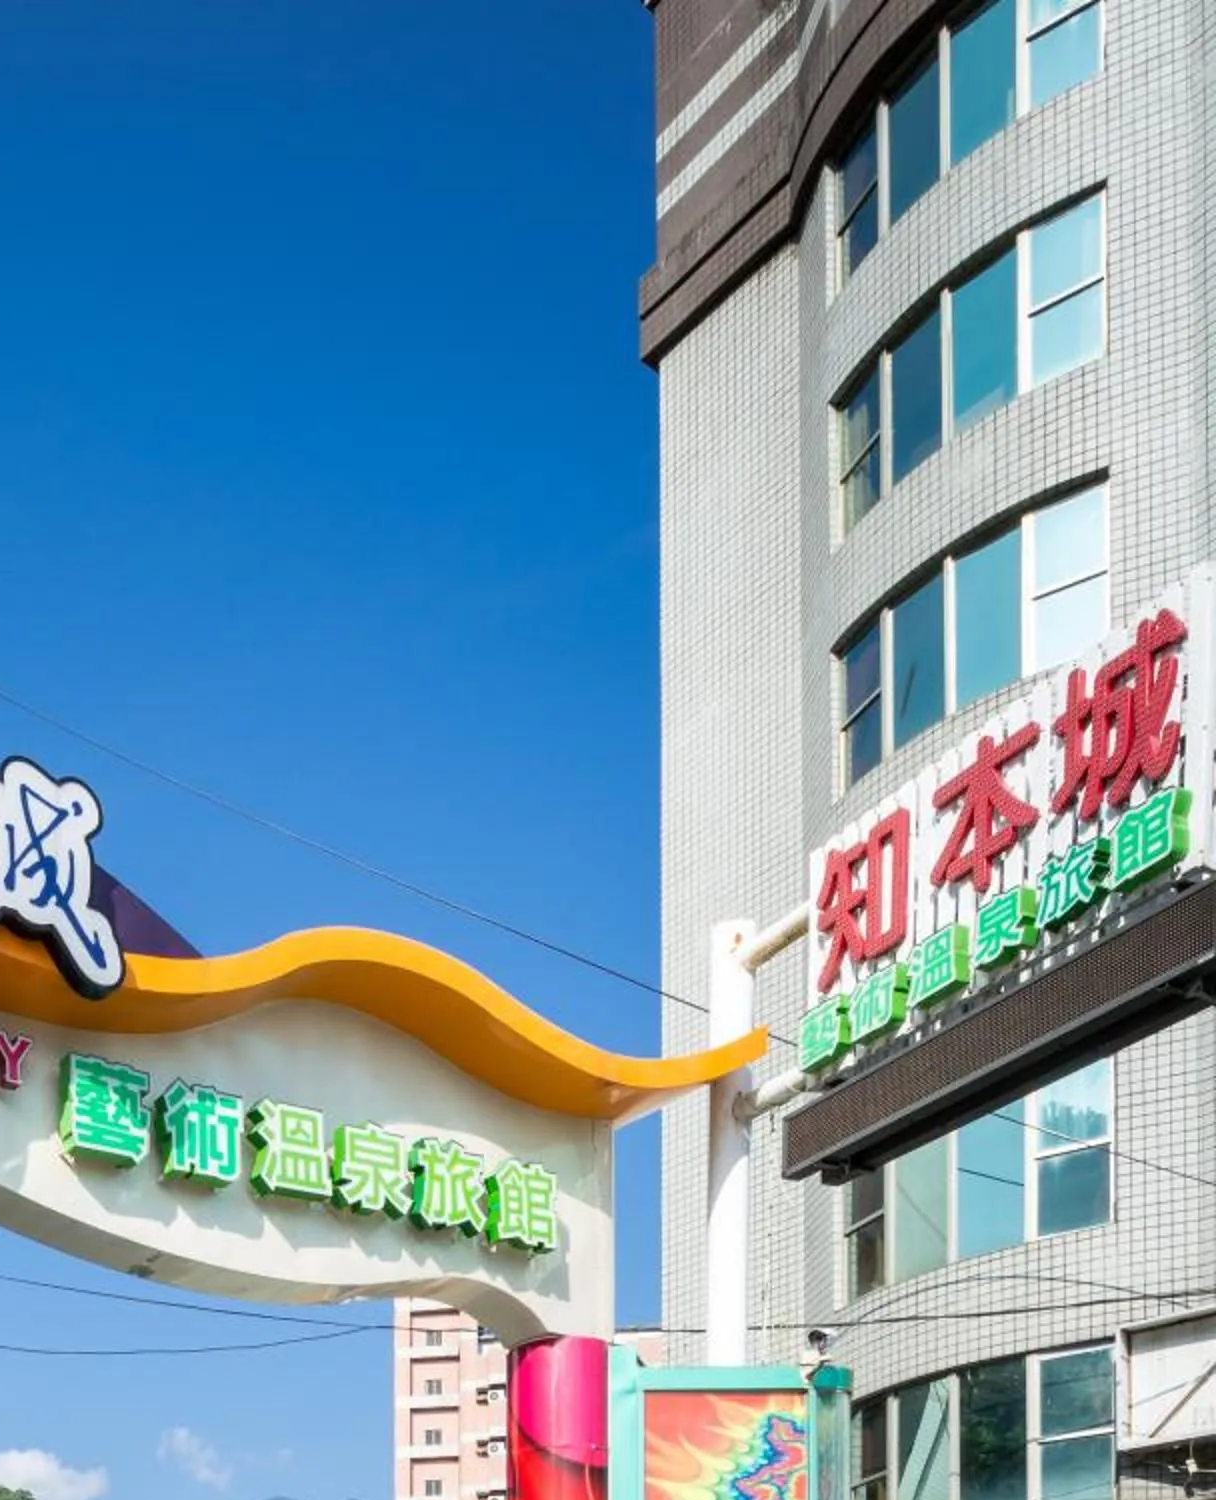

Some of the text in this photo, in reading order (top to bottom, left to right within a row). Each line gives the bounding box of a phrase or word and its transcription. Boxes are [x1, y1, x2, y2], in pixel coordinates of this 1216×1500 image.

[799, 788, 1188, 1072] 藝術溫泉旅館
[816, 607, 1189, 993] 知本城
[65, 1053, 558, 1252] 藝術溫泉旅館
